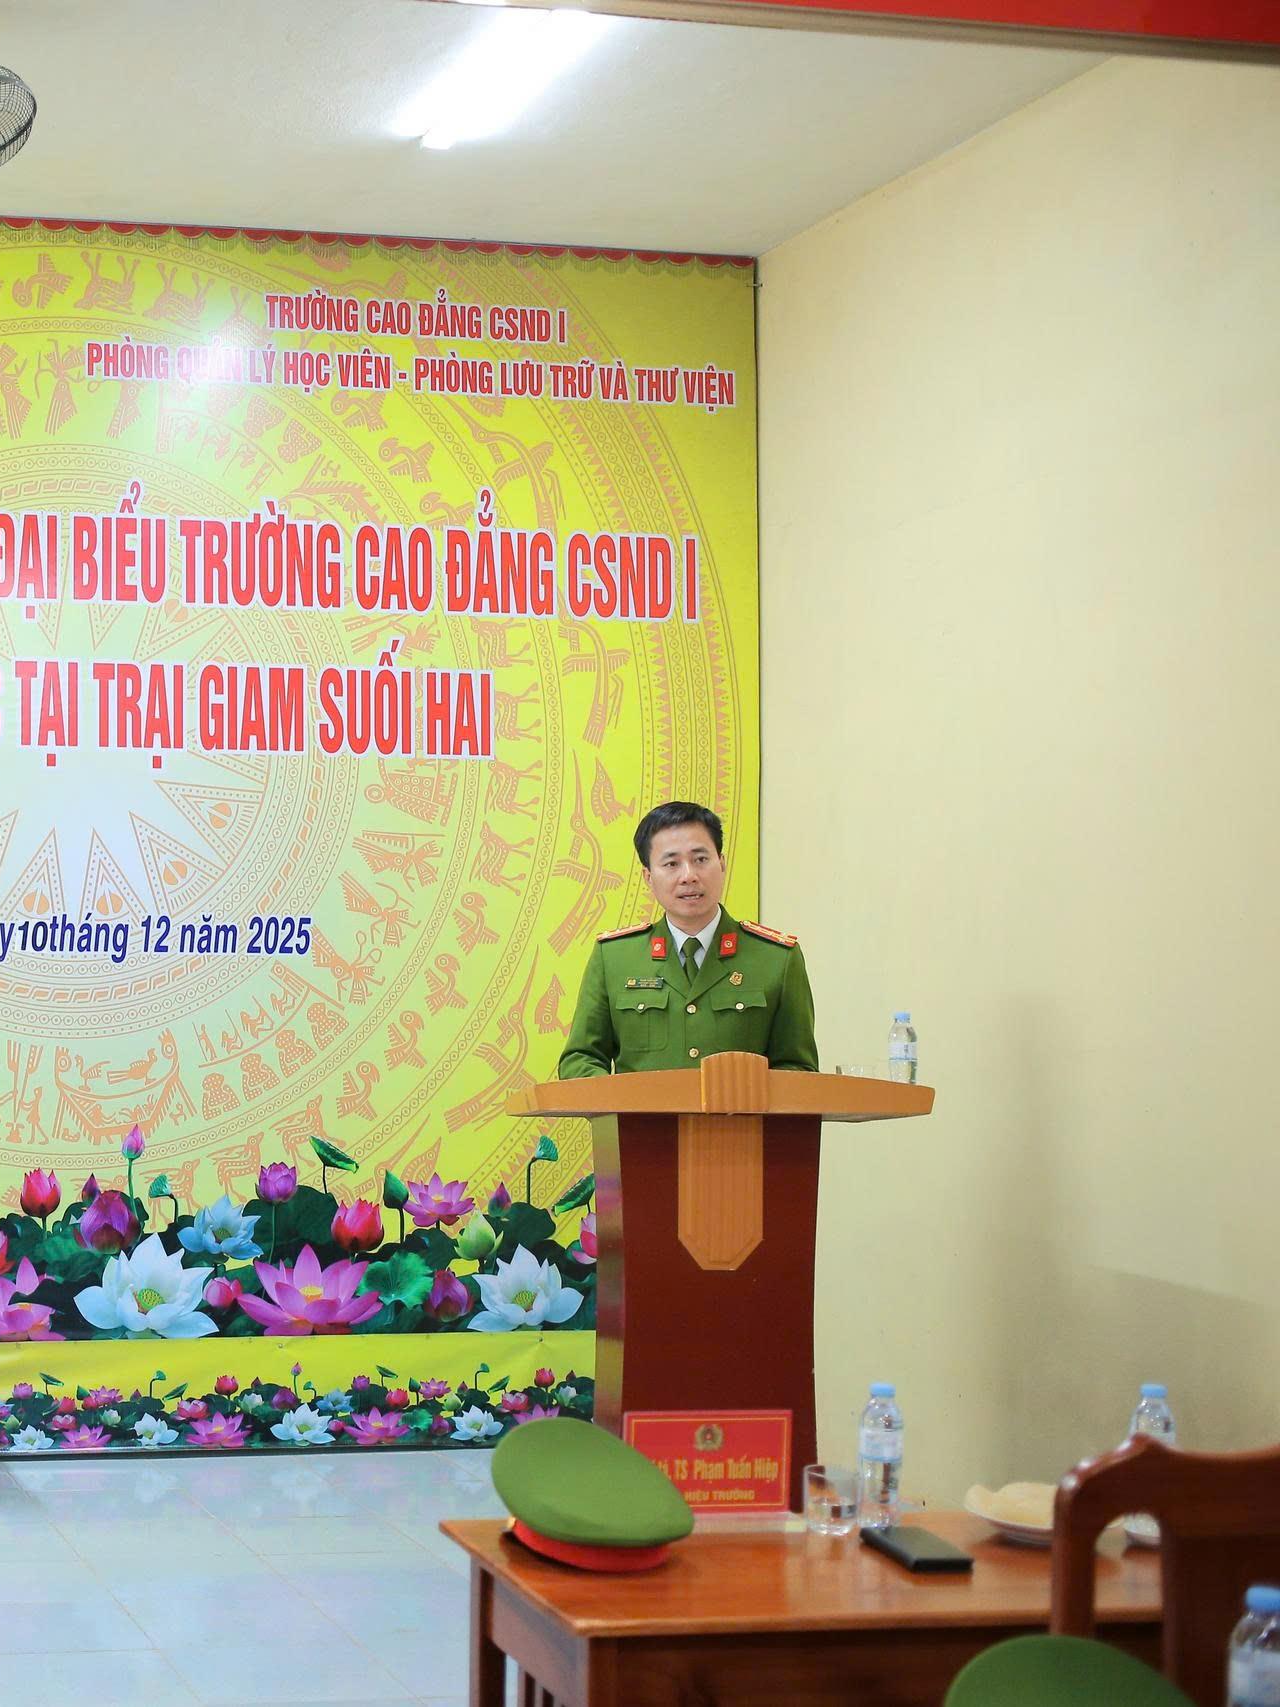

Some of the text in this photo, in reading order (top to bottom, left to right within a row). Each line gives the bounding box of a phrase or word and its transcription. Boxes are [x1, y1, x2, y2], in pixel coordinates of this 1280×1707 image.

[266, 288, 565, 343] TRƯỜNG CAO ĐẲNG CSND I
[87, 336, 169, 380] PHÒNG
[249, 344, 276, 385] LÝ
[284, 352, 330, 393] HỌC
[337, 348, 391, 389] VIÊN
[414, 351, 493, 394] PHÒNG
[500, 359, 543, 397] LƯU
[550, 359, 595, 398] TRỮ
[599, 360, 628, 400] VÀ
[635, 367, 679, 403] THƯ
[683, 365, 734, 412] VIỆN
[74, 481, 166, 604] BIỂU
[180, 501, 341, 610] TRƯỜNG
[356, 525, 433, 613] CAO
[446, 490, 554, 616] ĐẲNG
[568, 534, 672, 619] CSND
[685, 539, 697, 620] I
[16, 661, 78, 767] TẠI
[93, 663, 184, 769] TRẠI
[199, 665, 304, 752] GIAM
[320, 640, 412, 755] SUỐI
[426, 671, 492, 757] HAI
[141, 915, 171, 953] 12
[179, 914, 238, 953] năm
[247, 916, 312, 955] 2025
[694, 1458, 725, 1484] Phạm
